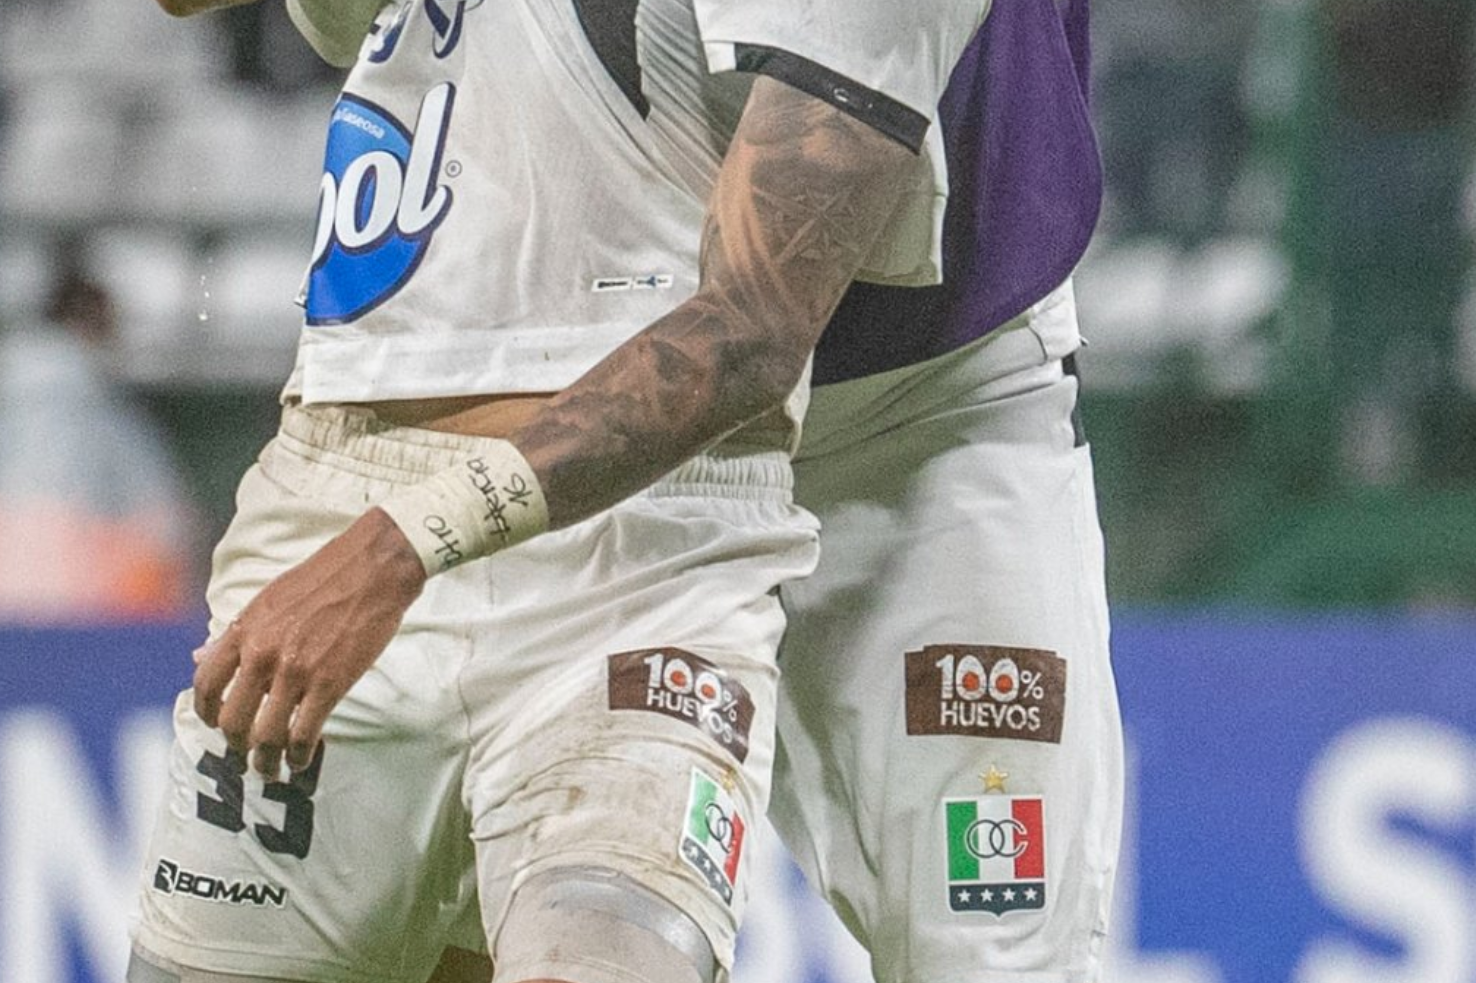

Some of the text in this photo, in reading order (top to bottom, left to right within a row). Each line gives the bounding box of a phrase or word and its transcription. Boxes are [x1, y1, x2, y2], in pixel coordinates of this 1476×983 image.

[644, 653, 738, 722] 100%
[935, 654, 1045, 702] 100%
[646, 688, 733, 744] HUEVOS
[939, 701, 1042, 732] HUEVOS
[175, 871, 288, 906] BOMAN
